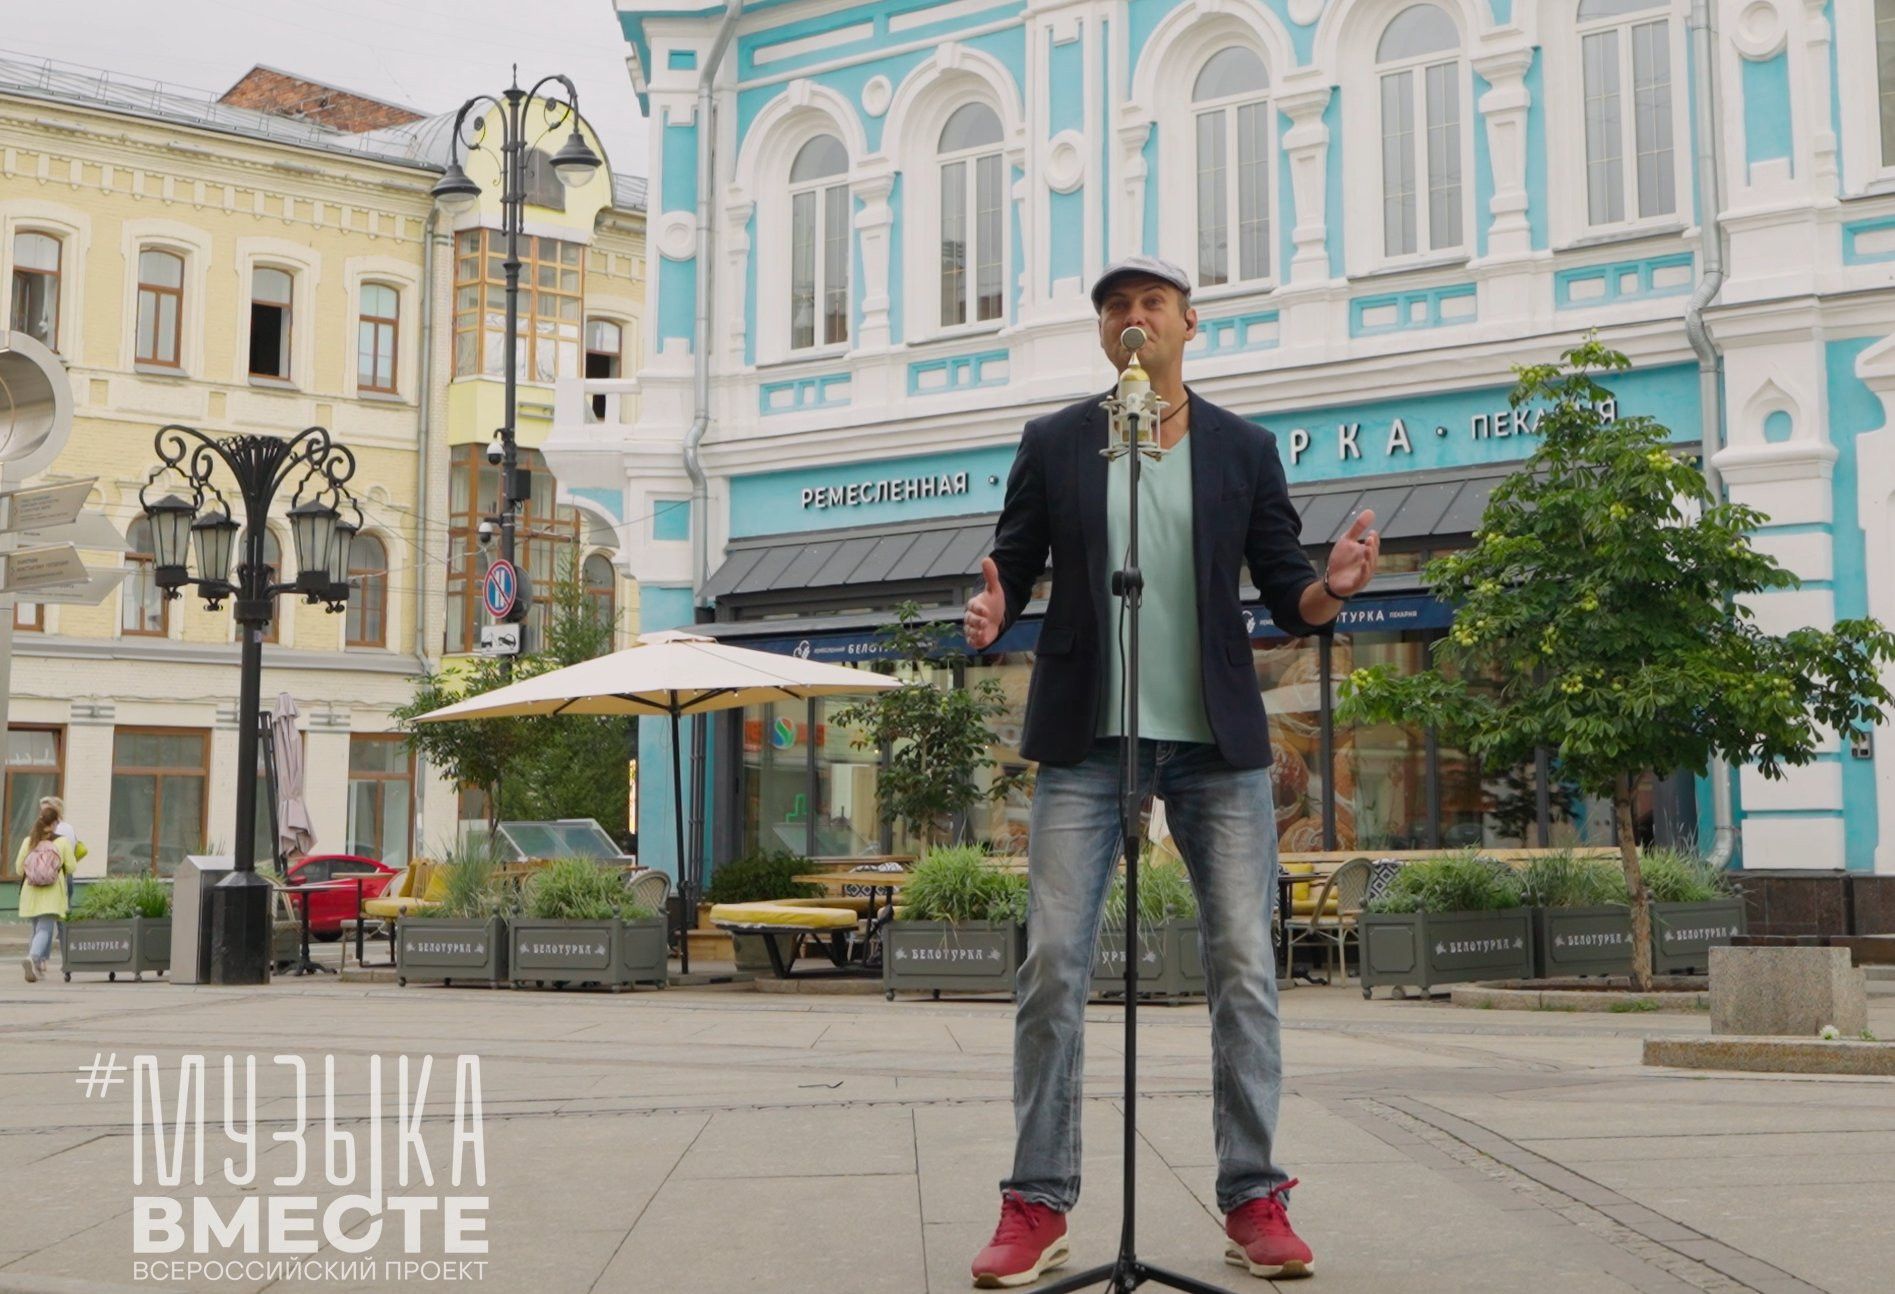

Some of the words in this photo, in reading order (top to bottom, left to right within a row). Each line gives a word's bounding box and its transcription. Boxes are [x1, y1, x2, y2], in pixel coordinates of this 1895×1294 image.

[801, 472, 969, 509] РЕМЕСЛЕННАЯ
[1471, 399, 1618, 441] ПЕКАЯ
[1336, 610, 1384, 624] ТУРКА
